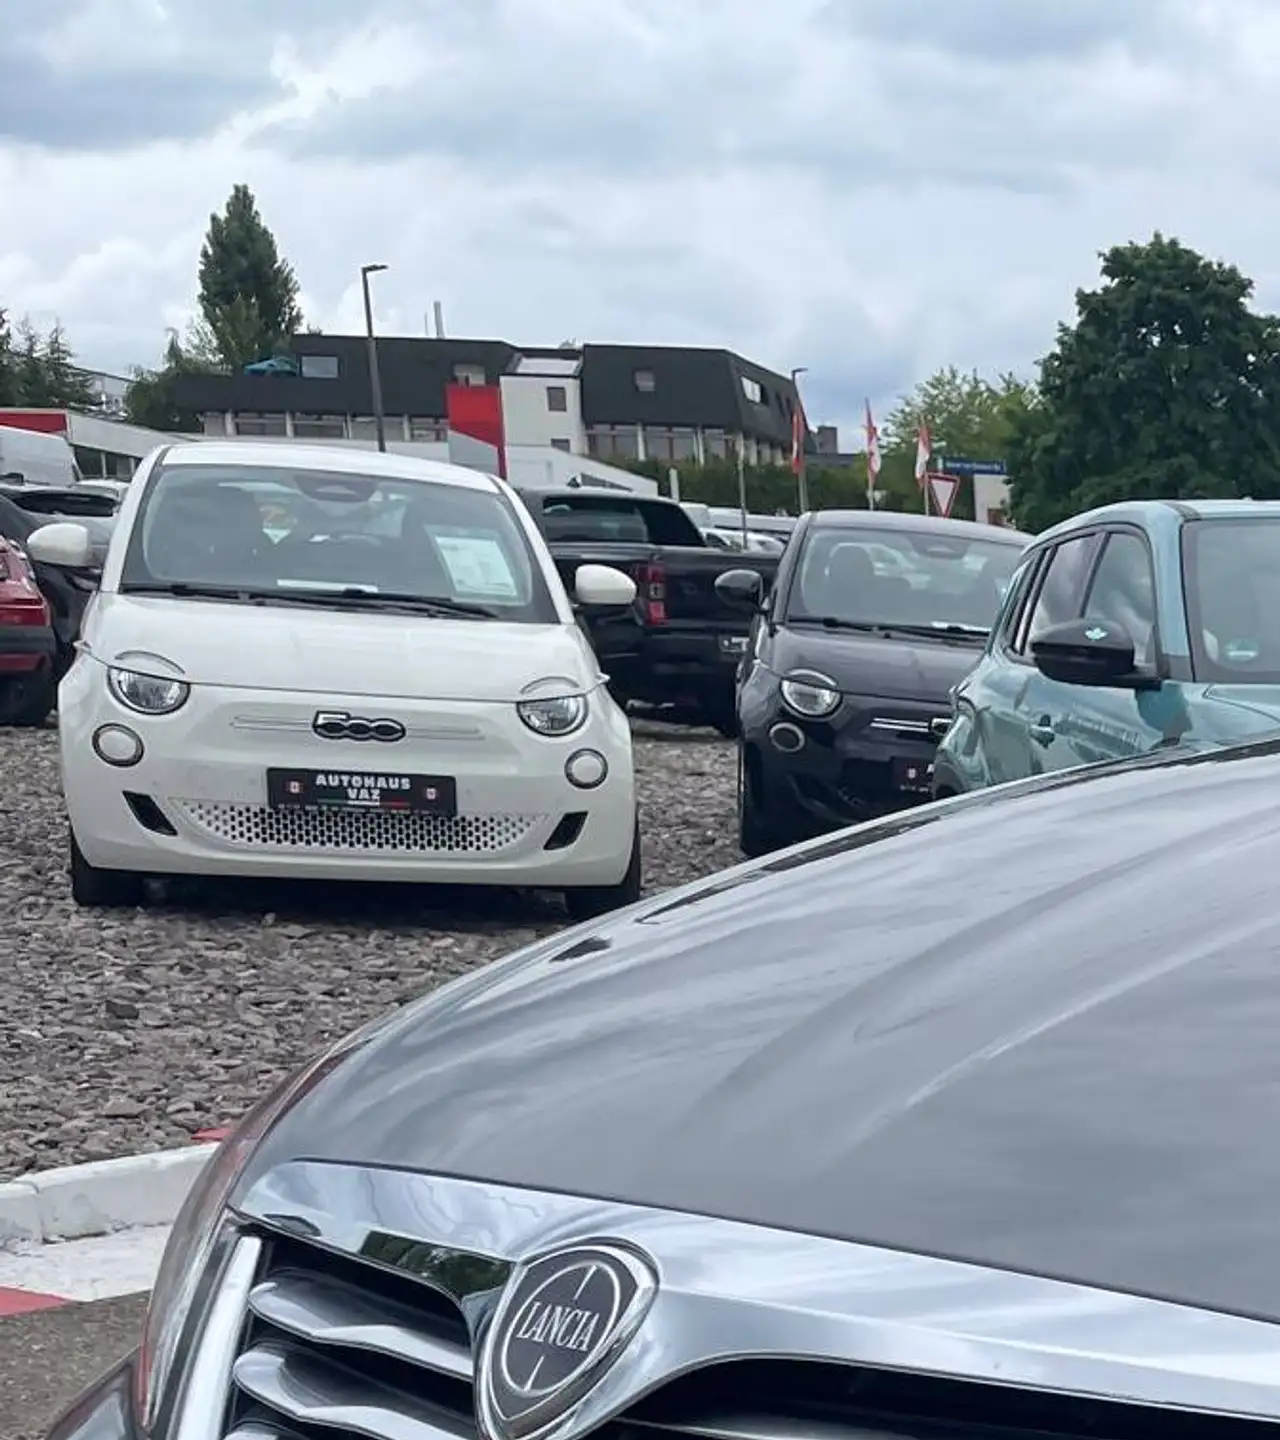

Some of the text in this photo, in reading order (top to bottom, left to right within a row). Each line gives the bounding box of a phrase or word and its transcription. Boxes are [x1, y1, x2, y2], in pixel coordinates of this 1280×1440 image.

[313, 711, 406, 742] 500
[315, 774, 411, 790] AUTOHAUS
[347, 788, 381, 801] VAZ
[516, 1300, 600, 1352] LANCIA
